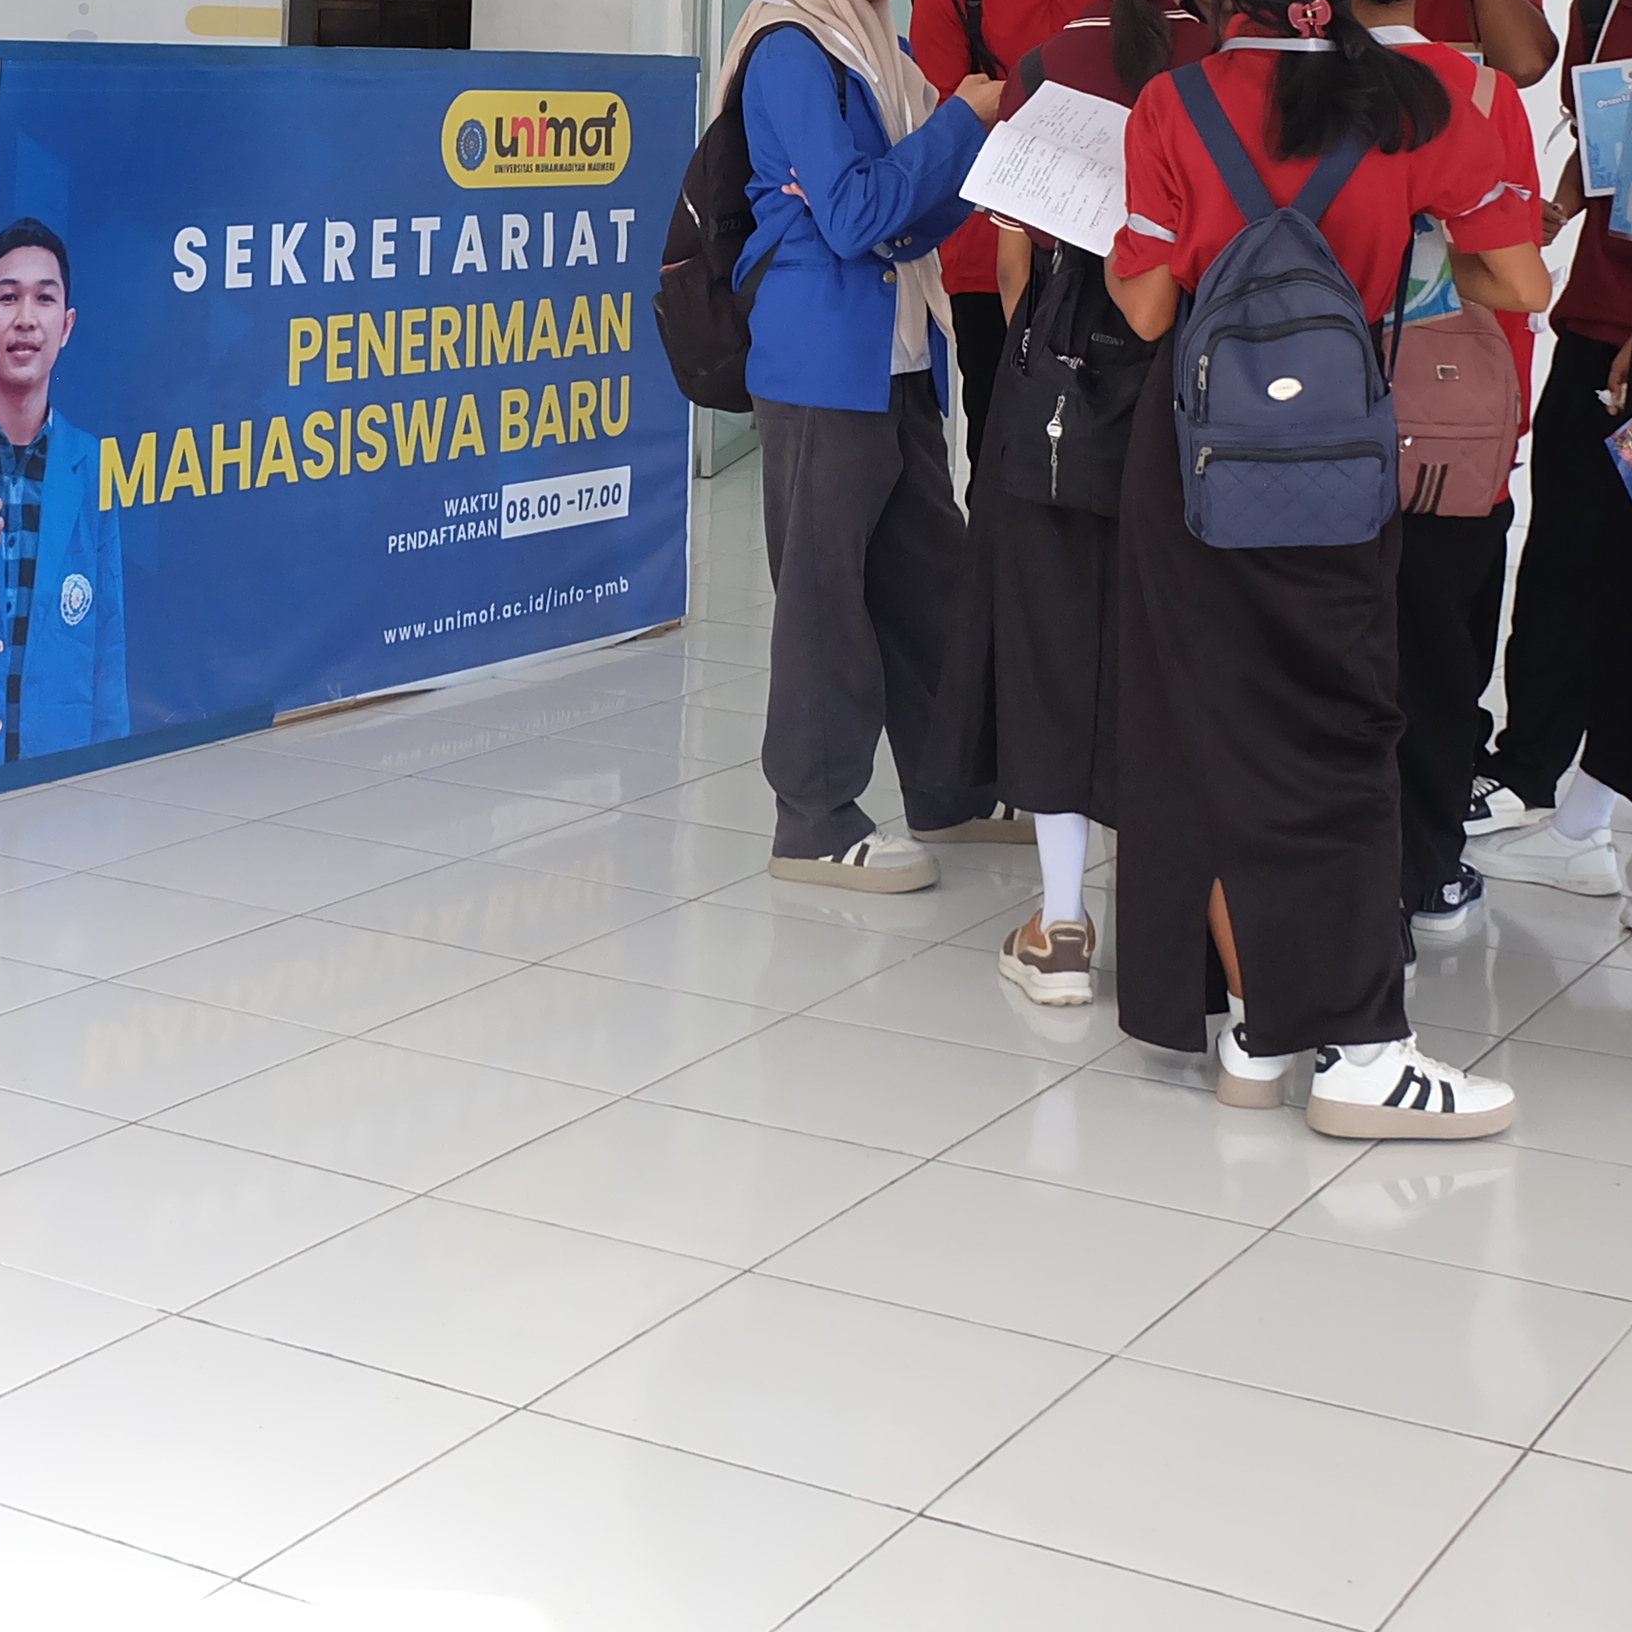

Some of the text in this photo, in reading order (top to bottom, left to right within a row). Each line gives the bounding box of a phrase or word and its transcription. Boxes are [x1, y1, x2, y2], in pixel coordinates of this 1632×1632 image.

[494, 100, 618, 158] unimof
[172, 208, 636, 294] SEKRETARIAT
[287, 291, 633, 387] PENERIMAAN
[98, 374, 631, 512] MAHASISWA BARU
[388, 518, 499, 555] PENDAFTARAN
[444, 492, 499, 518] WAKTU
[505, 493, 562, 524] 08.00
[383, 575, 630, 645] www.unimof.ac.id/info-pmb
